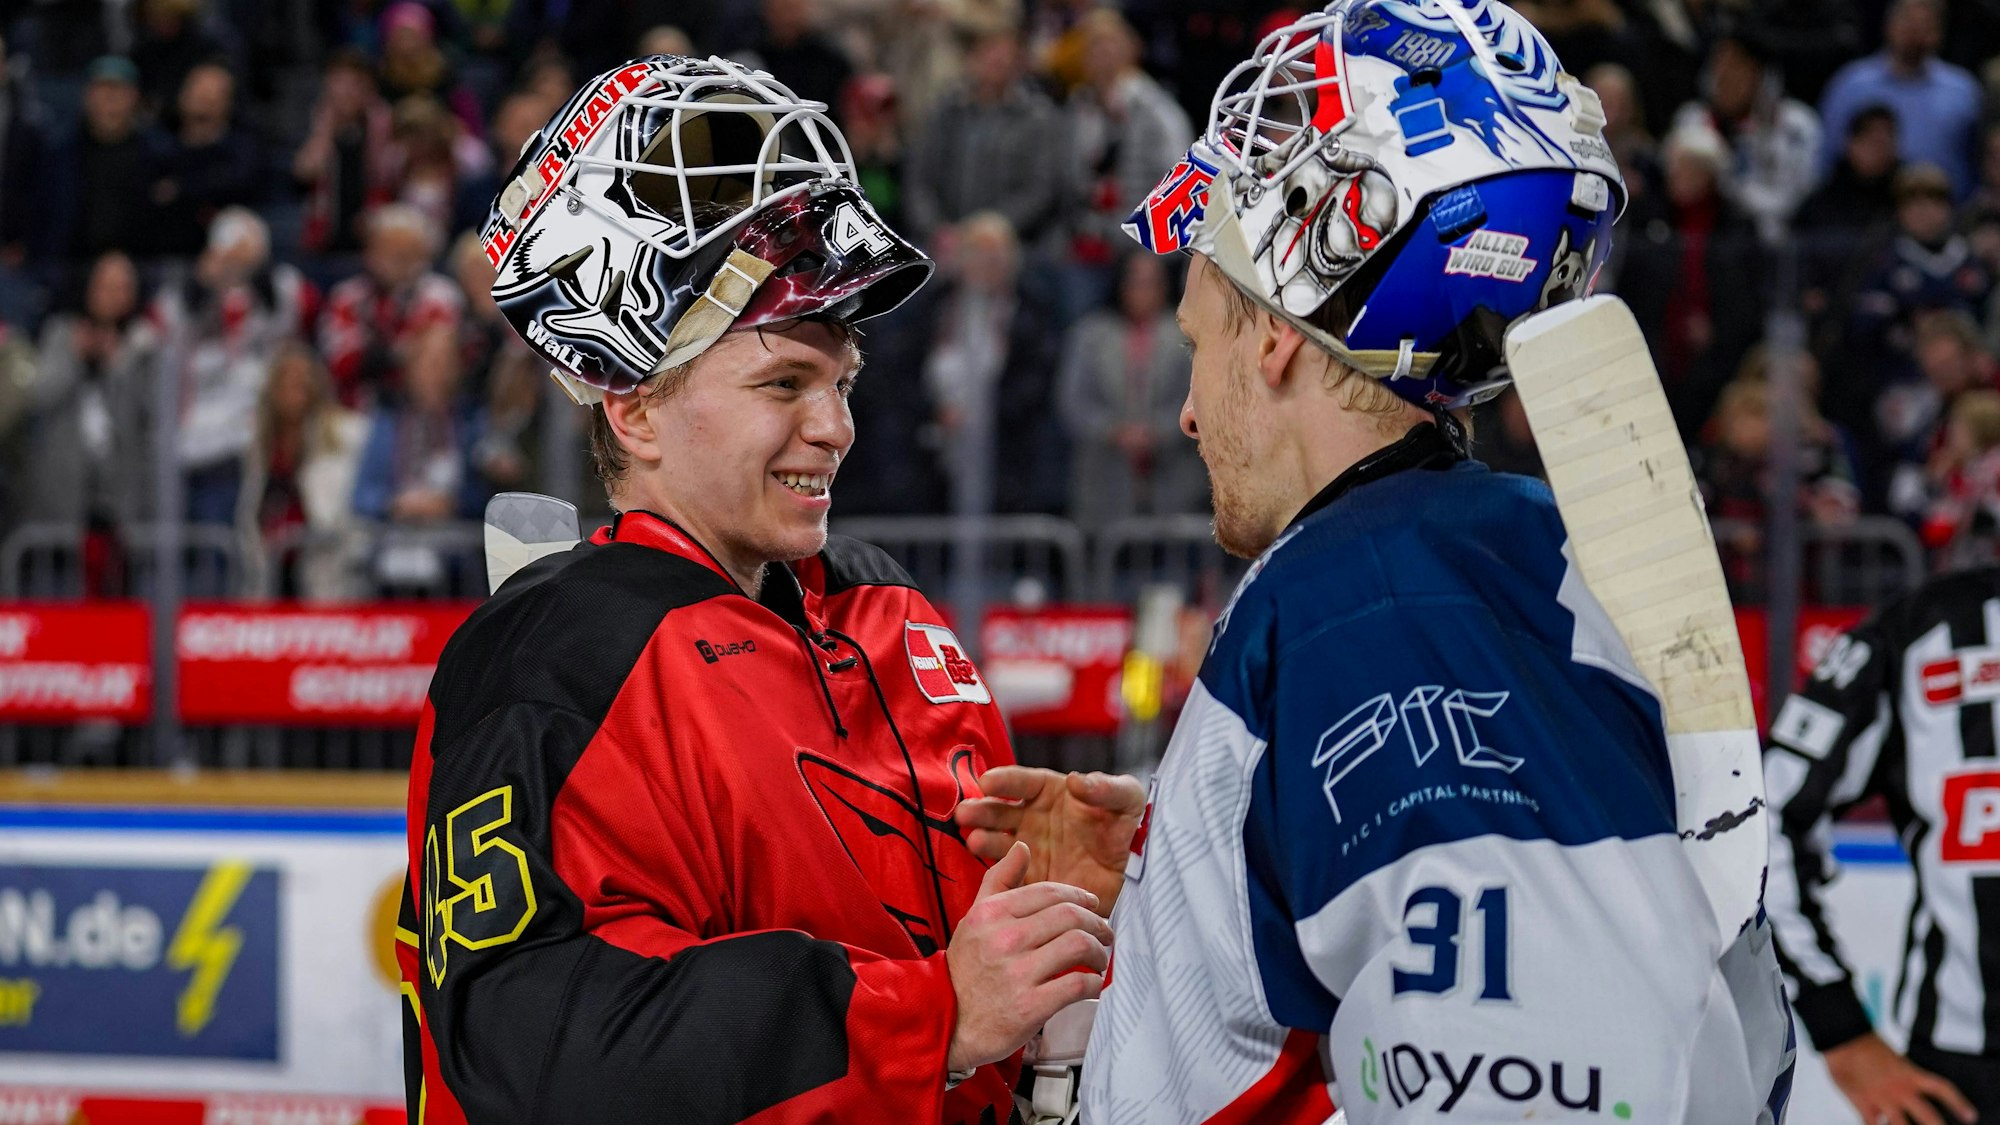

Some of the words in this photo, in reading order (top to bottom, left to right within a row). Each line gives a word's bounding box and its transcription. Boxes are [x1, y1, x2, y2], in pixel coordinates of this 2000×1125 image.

[832, 201, 895, 257] 4
[1469, 231, 1525, 256] ALLES
[1450, 251, 1496, 273] WIRD
[1496, 258, 1533, 278] GUT
[1388, 784, 1457, 817] CAPITAL
[426, 785, 538, 990] 45
[1392, 884, 1516, 1004] 31
